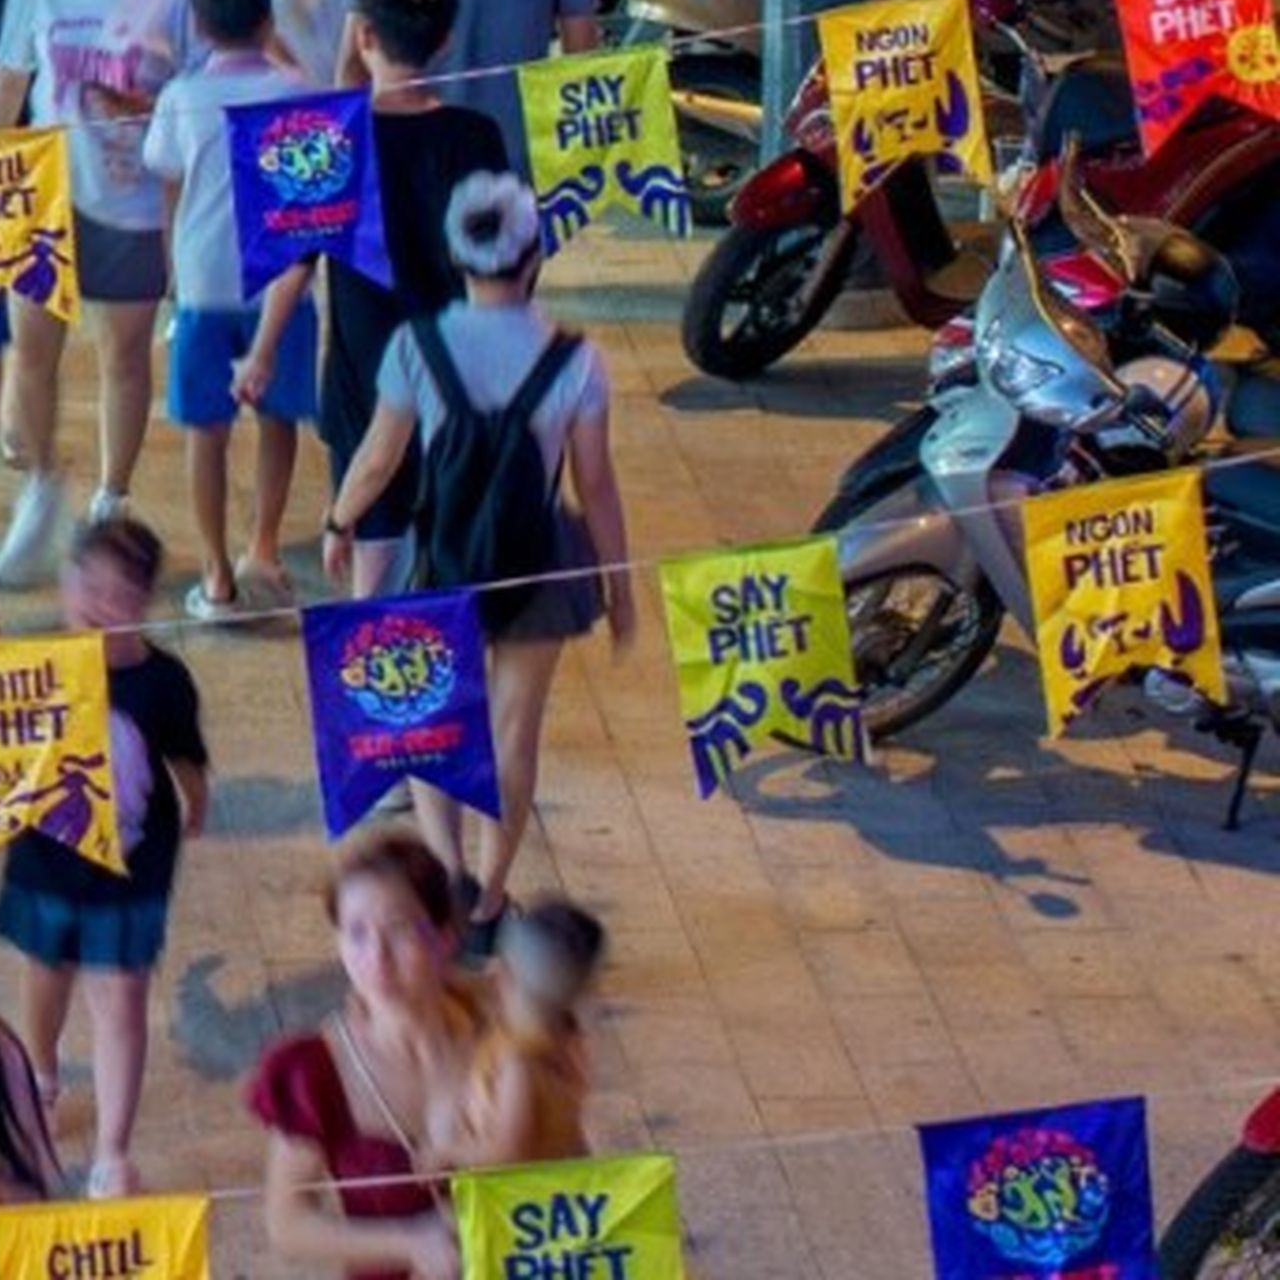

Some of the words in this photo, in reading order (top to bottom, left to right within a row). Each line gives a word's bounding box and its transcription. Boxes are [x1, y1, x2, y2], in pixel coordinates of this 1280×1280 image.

[854, 24, 929, 56] NGON
[560, 74, 624, 114] SAY
[1063, 508, 1151, 544] NGON
[709, 574, 786, 624] SAY
[512, 1192, 608, 1250] SAY
